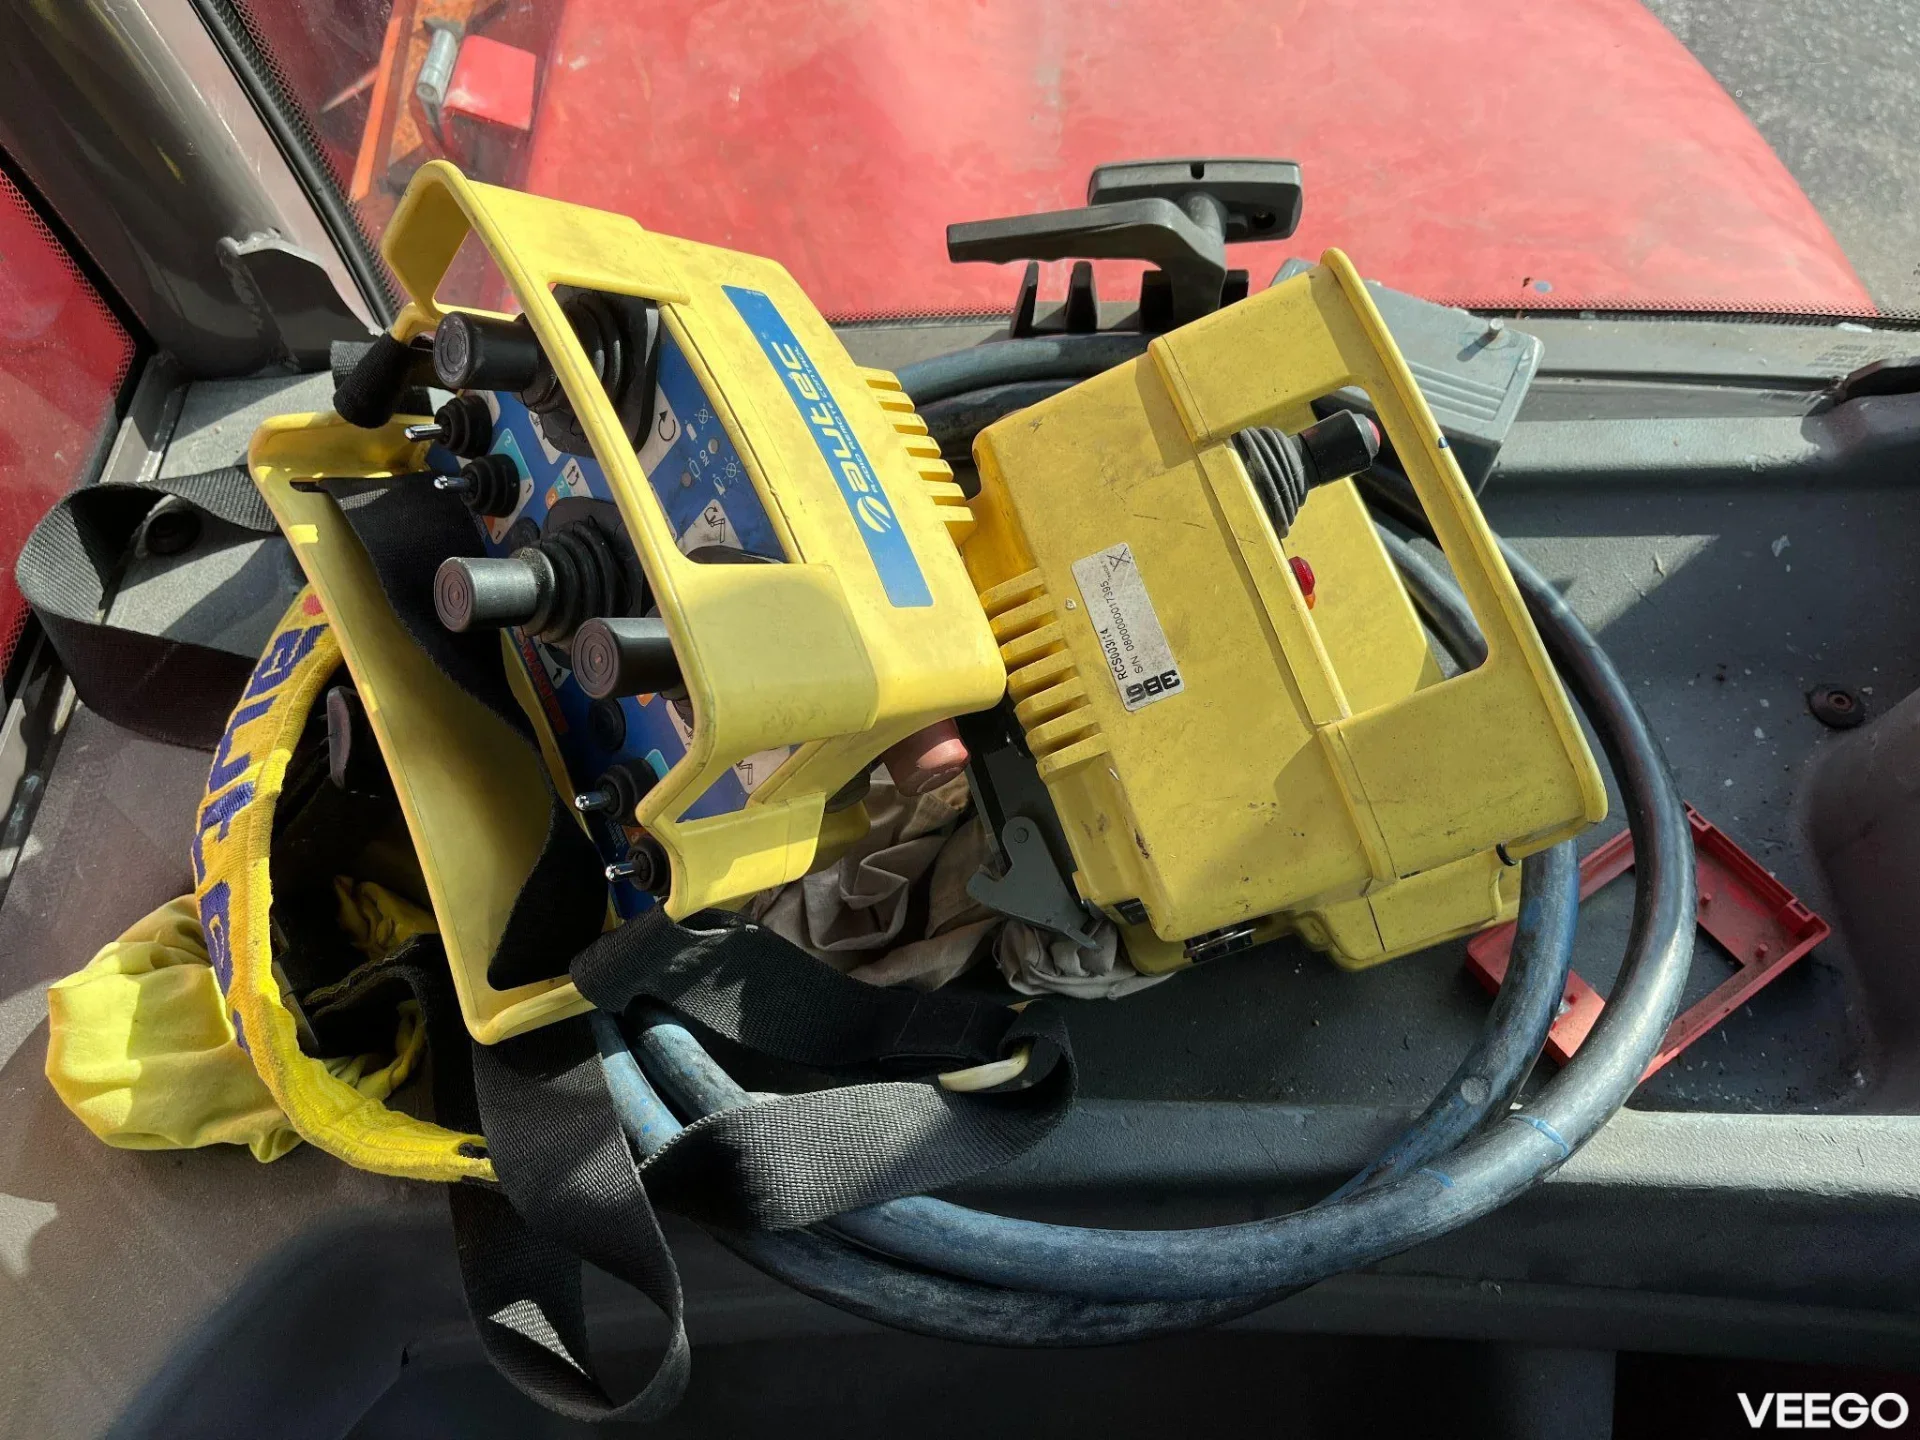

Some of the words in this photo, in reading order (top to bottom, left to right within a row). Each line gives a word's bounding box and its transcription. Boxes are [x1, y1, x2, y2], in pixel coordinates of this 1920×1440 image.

[794, 345, 828, 399] CONTROL
[771, 341, 869, 492] autec
[826, 401, 856, 451] REMOTE
[855, 453, 878, 493] RADIO
[1127, 669, 1181, 704] 3B6
[1131, 655, 1144, 674] S/N
